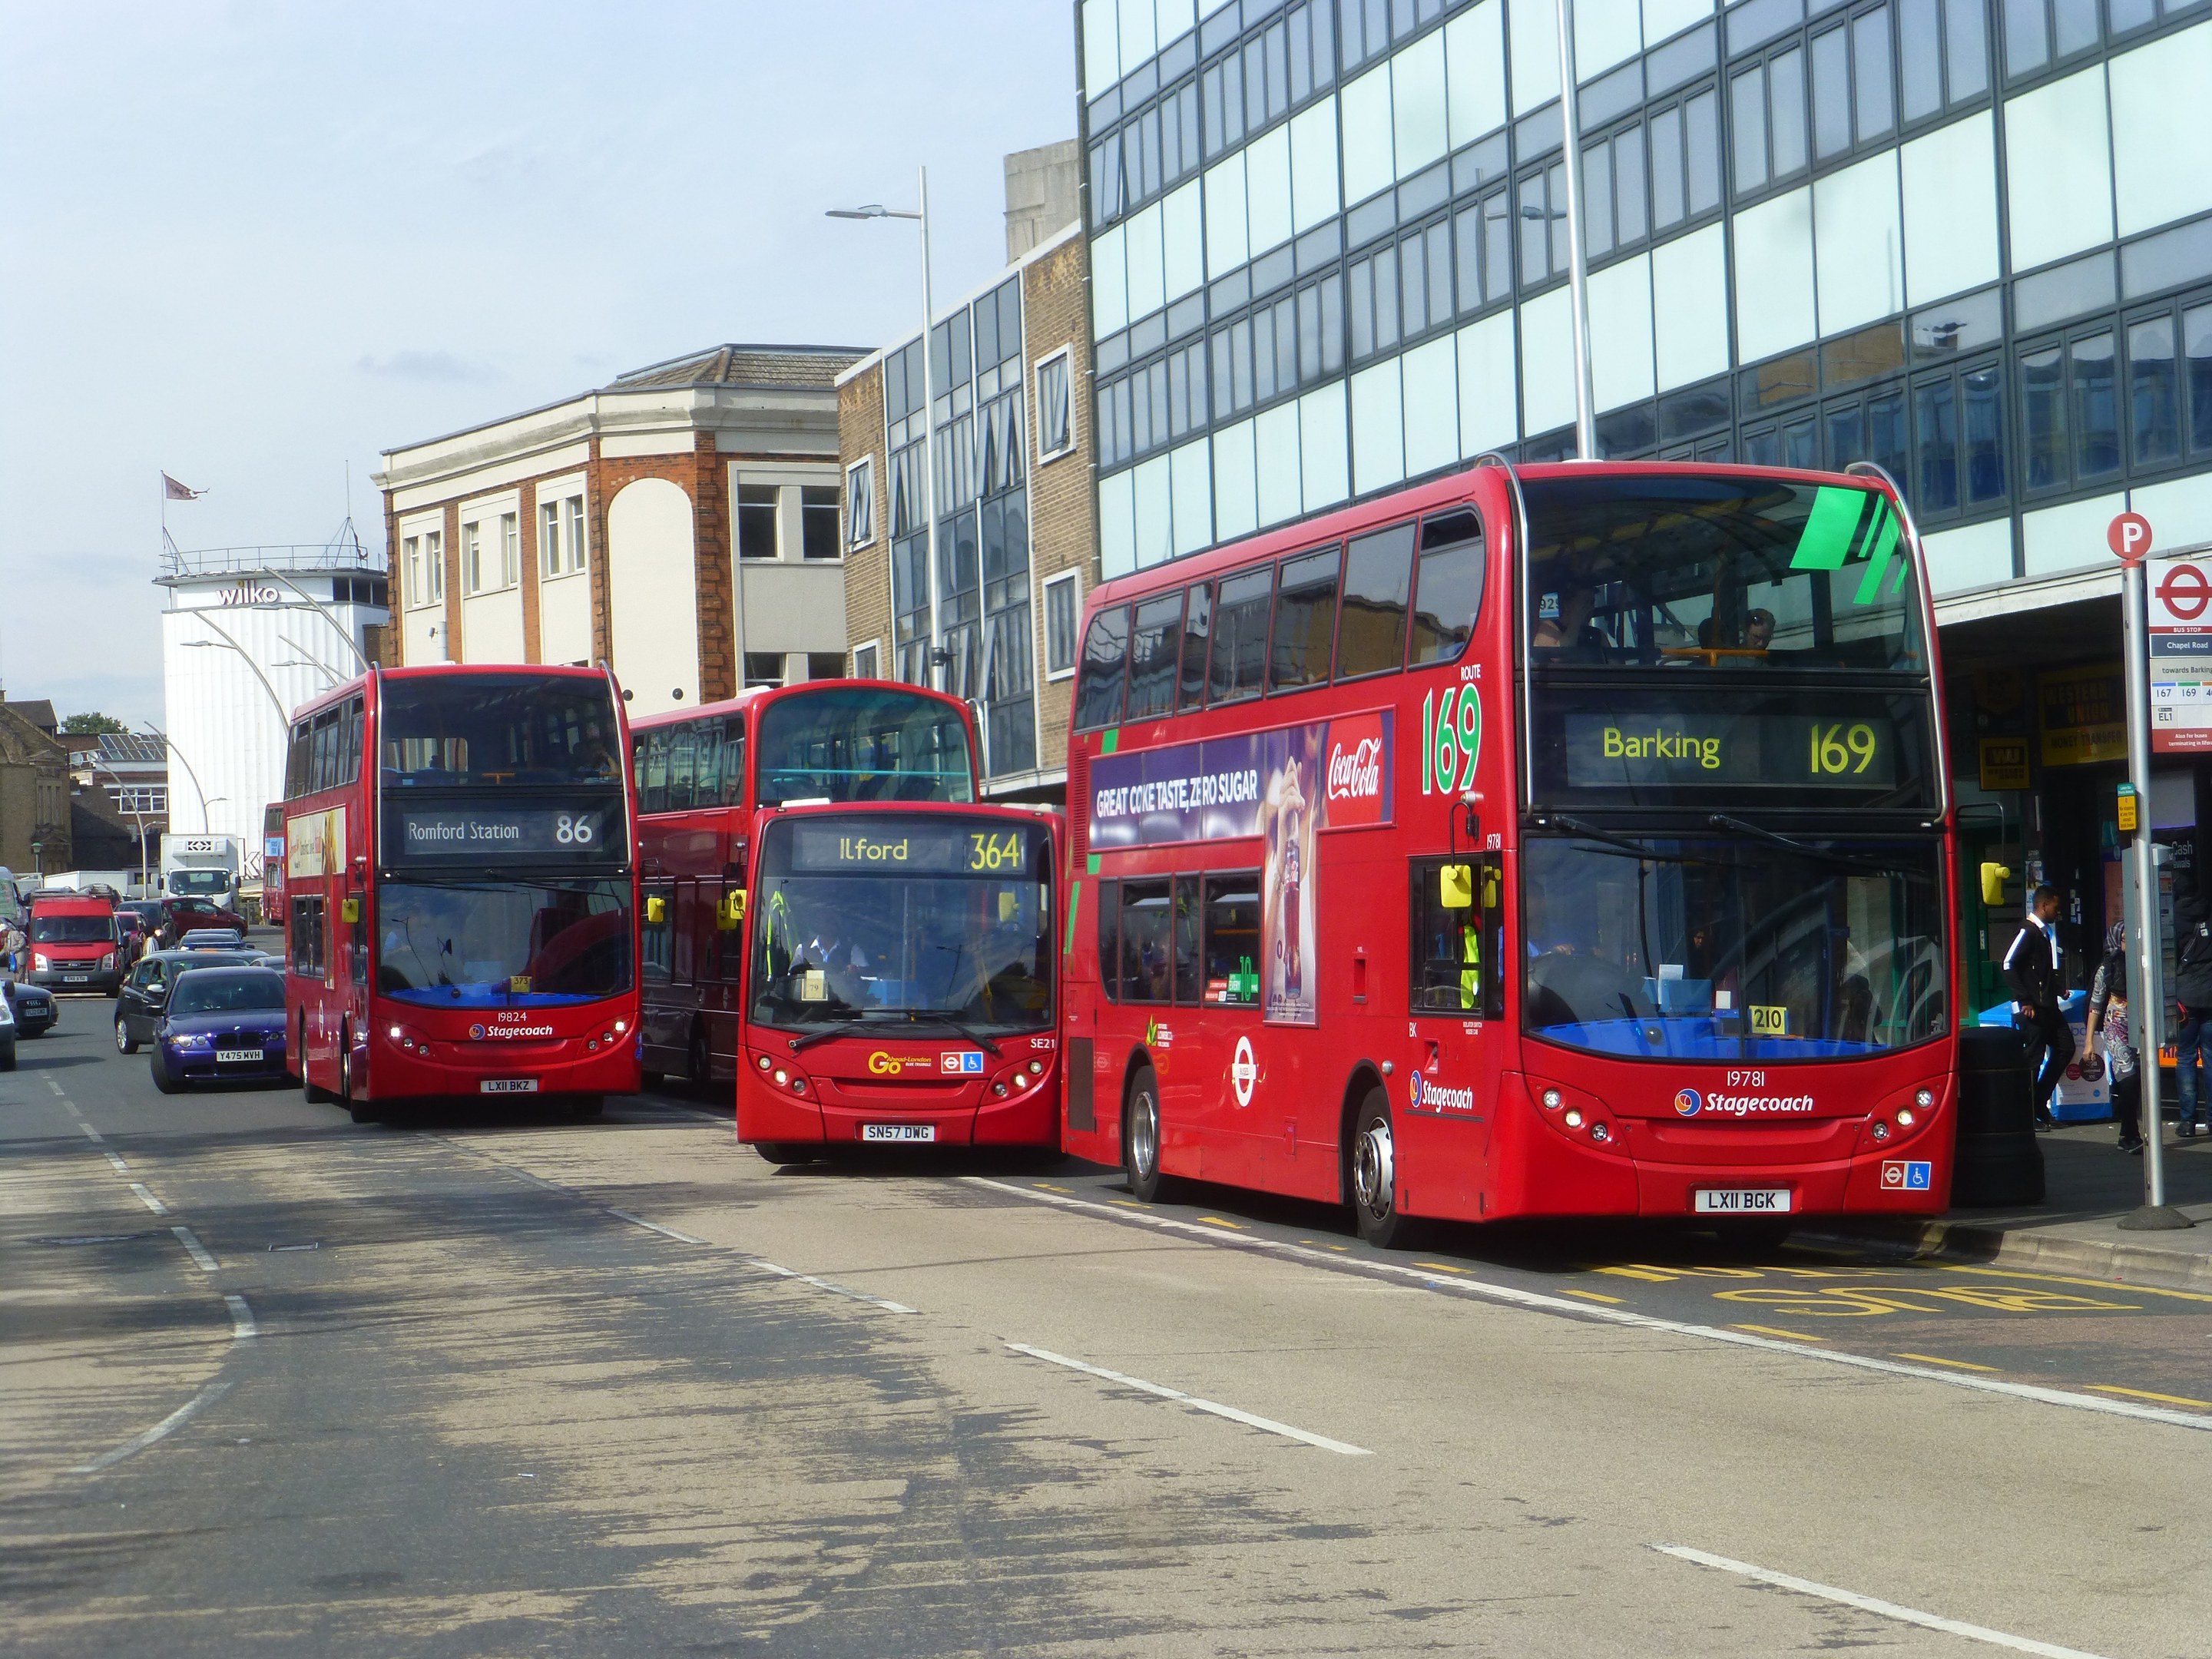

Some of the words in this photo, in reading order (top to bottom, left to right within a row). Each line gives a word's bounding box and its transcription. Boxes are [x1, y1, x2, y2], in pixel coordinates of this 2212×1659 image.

[2122, 522, 2142, 552] P
[216, 579, 279, 605] wilko
[2167, 641, 2190, 650] Chapel
[1461, 664, 1481, 680] ROUTE
[2157, 688, 2171, 697] 167
[2182, 688, 2197, 697] 169
[2159, 713, 2172, 721] EL1
[1422, 683, 1482, 795] 169
[1604, 727, 1720, 769] Barking
[1811, 724, 1876, 773] 169
[1097, 787, 1128, 818] GREAT
[1130, 783, 1154, 814] COKE
[1156, 779, 1189, 813] TASTE,
[1190, 774, 1217, 806] ZERO
[1218, 770, 1257, 803] SUGAR
[409, 822, 464, 840] Romford
[470, 822, 518, 839] Station
[556, 815, 592, 843] 86
[1487, 833, 1501, 849] 19781
[2172, 840, 2193, 855] Cash
[840, 838, 908, 860] Ilford
[971, 833, 1019, 869] 364
[1240, 955, 1252, 1002] 10
[498, 1012, 527, 1022] 19824
[1754, 1009, 1782, 1028] 210
[487, 1025, 553, 1039] Stagecoach
[1409, 1022, 1417, 1038] BK
[1030, 1038, 1055, 1048] SE21
[869, 1051, 901, 1074] Go
[488, 1081, 507, 1091] LX11
[510, 1081, 529, 1090] BKZ
[1727, 1071, 1764, 1087] 19781
[1422, 1080, 1473, 1113] Stagecoach
[1705, 1093, 1813, 1116] Stagecoach
[869, 1127, 901, 1138] SN57
[905, 1127, 929, 1138] DWG
[1708, 1192, 1739, 1209] LX11
[1743, 1192, 1776, 1209] BGK
